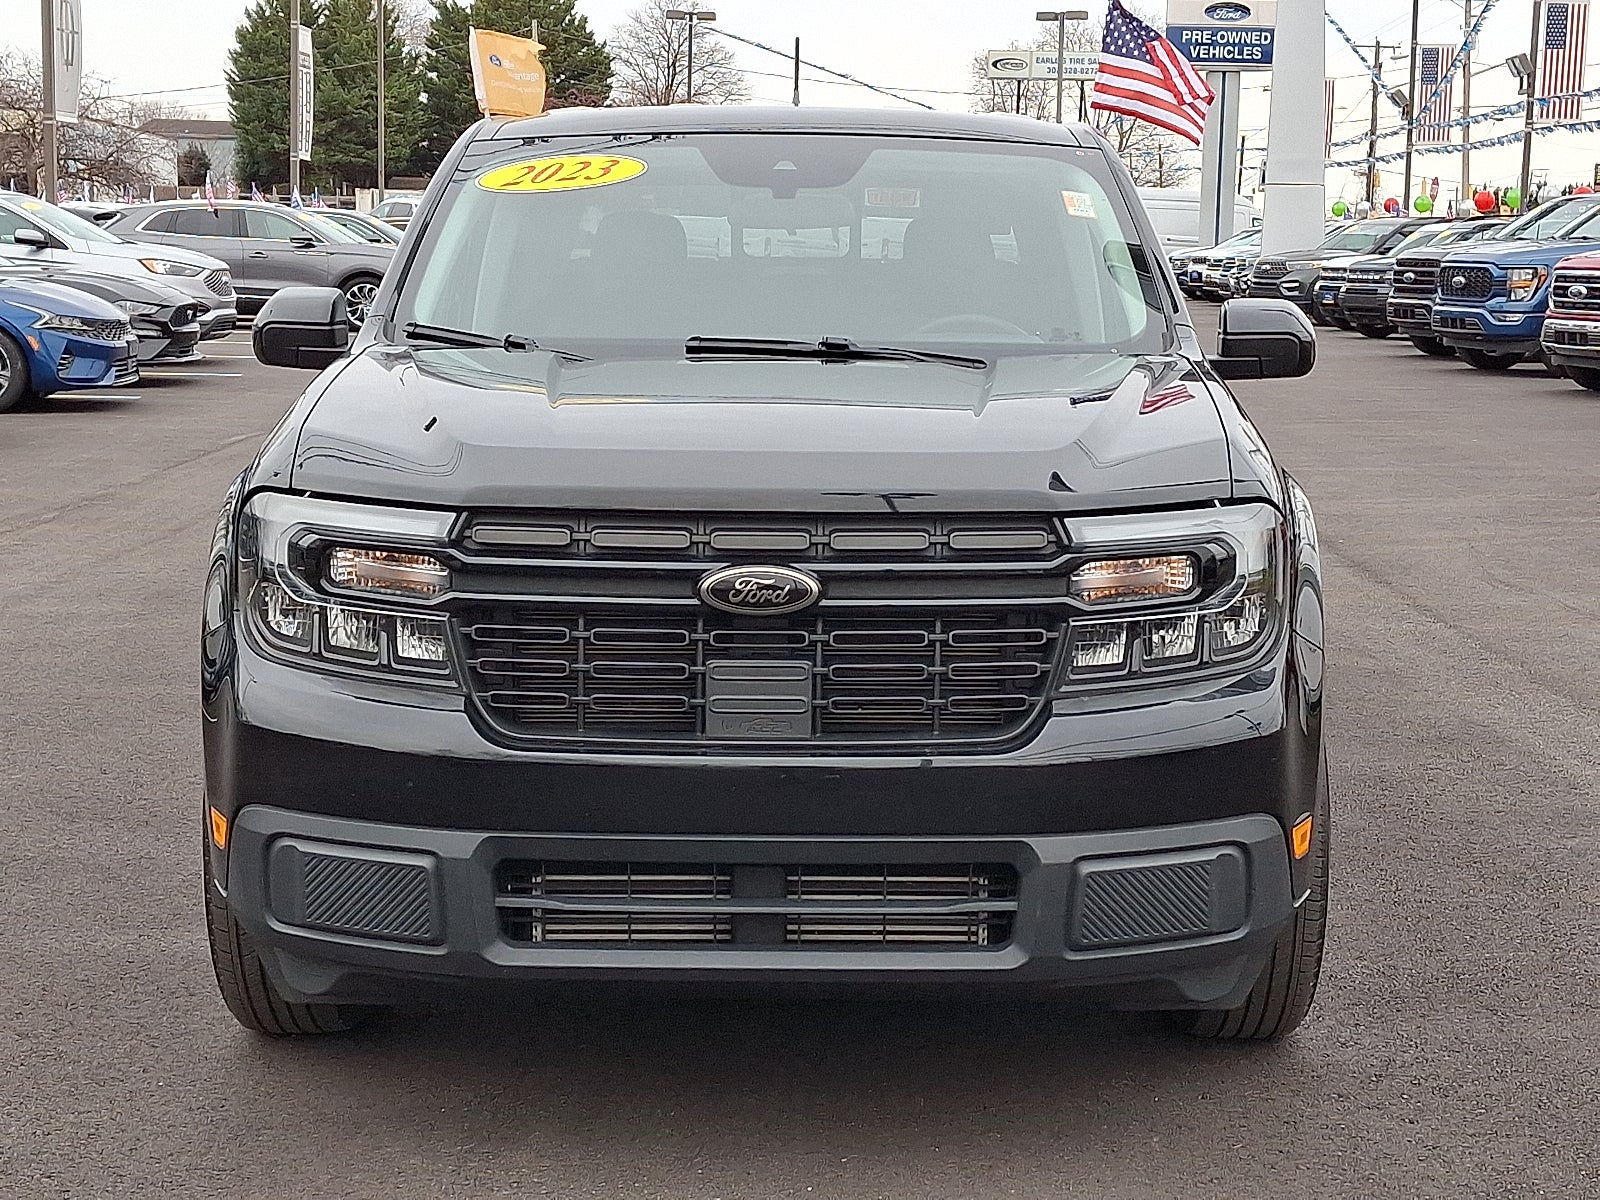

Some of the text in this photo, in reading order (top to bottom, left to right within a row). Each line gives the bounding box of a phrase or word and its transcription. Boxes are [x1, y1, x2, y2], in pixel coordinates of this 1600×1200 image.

[1213, 7, 1242, 20] Ford
[1181, 30, 1272, 45] PRE-OWNED
[1189, 45, 1263, 60] VEHICLES
[1069, 57, 1086, 65] TIRE
[499, 158, 621, 188] 2023
[728, 576, 791, 603] Ford
